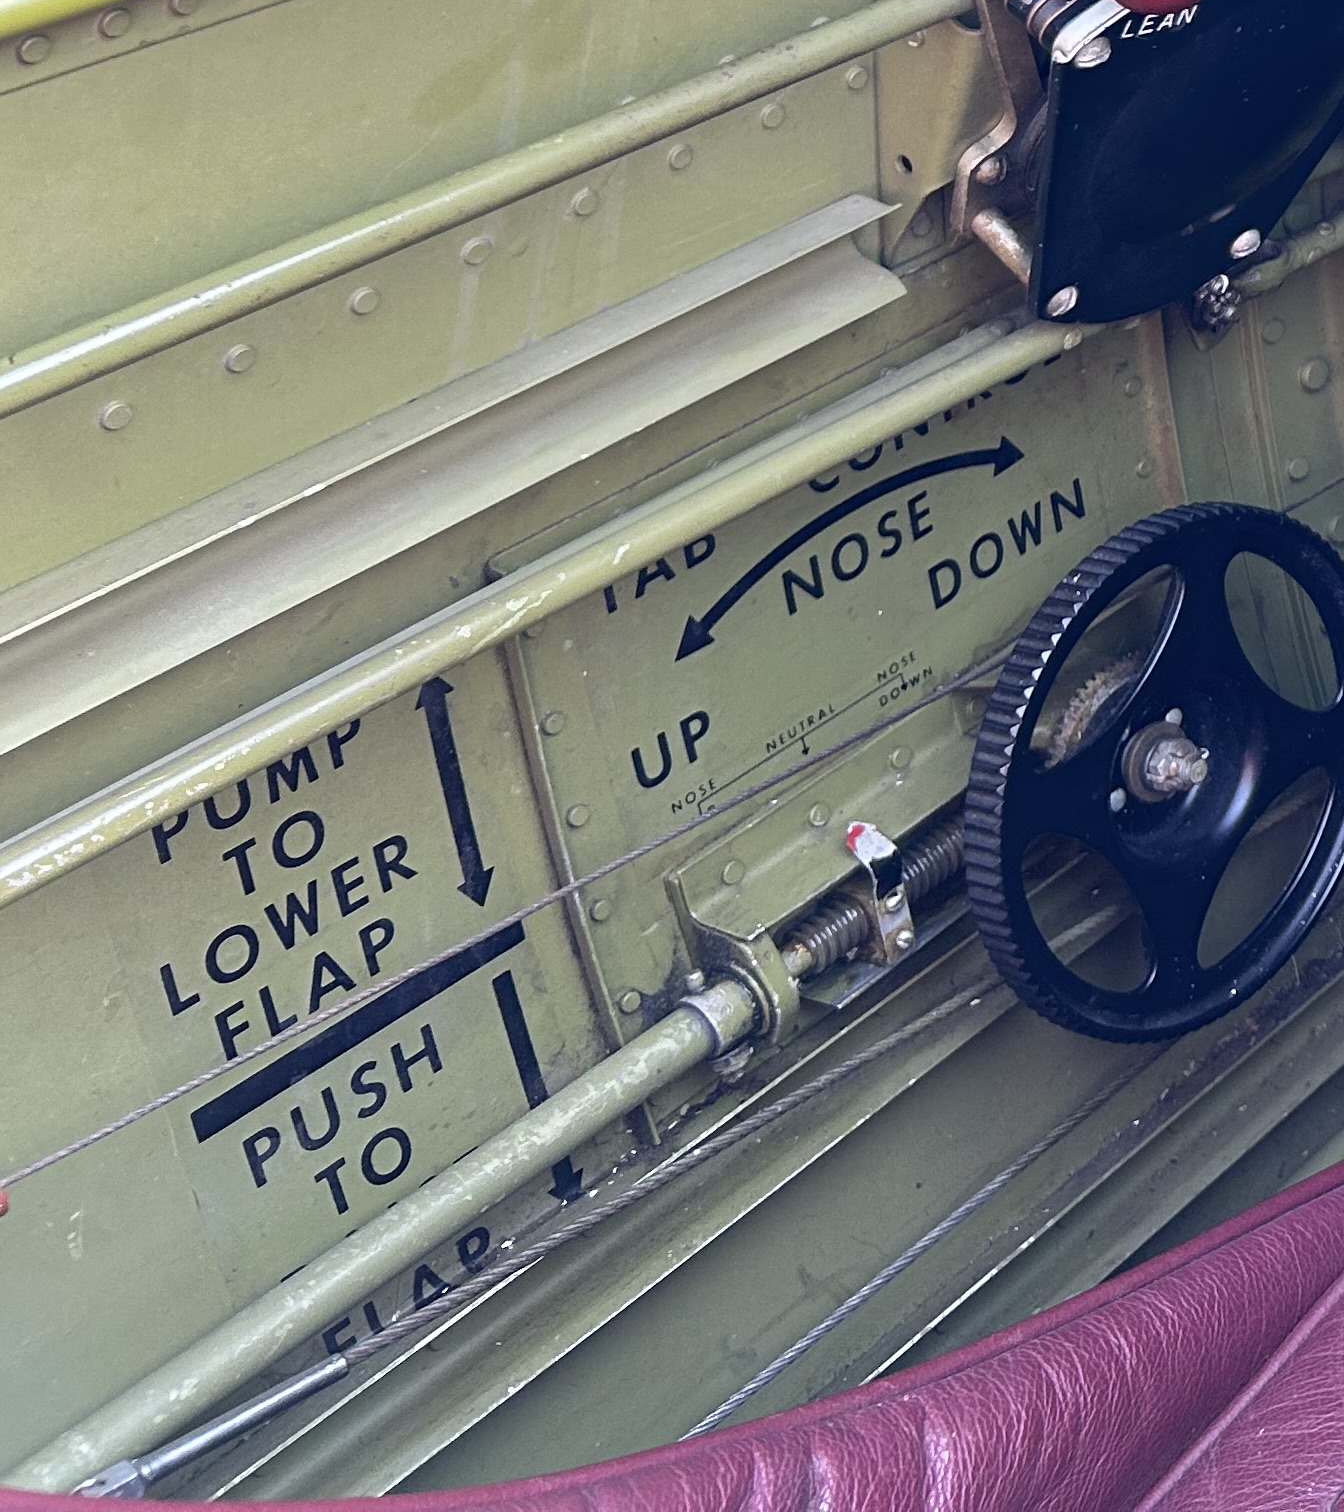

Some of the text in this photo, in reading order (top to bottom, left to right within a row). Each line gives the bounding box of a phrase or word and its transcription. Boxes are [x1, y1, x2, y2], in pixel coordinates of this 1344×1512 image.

[1120, 4, 1199, 40] LEAN
[781, 489, 935, 616] NOSE
[928, 477, 1088, 610] DOWN
[876, 650, 917, 683] NOSE
[879, 666, 934, 707] DOWN
[630, 709, 711, 790] UP
[765, 703, 836, 754] NEUTRAL
[150, 717, 362, 865] PUMP
[671, 778, 717, 814] NOSE
[222, 809, 325, 896] TO
[160, 834, 419, 1017] LOWER
[214, 917, 396, 1061] FLAP
[242, 1023, 444, 1189] PUSH
[313, 1125, 413, 1216] TO
